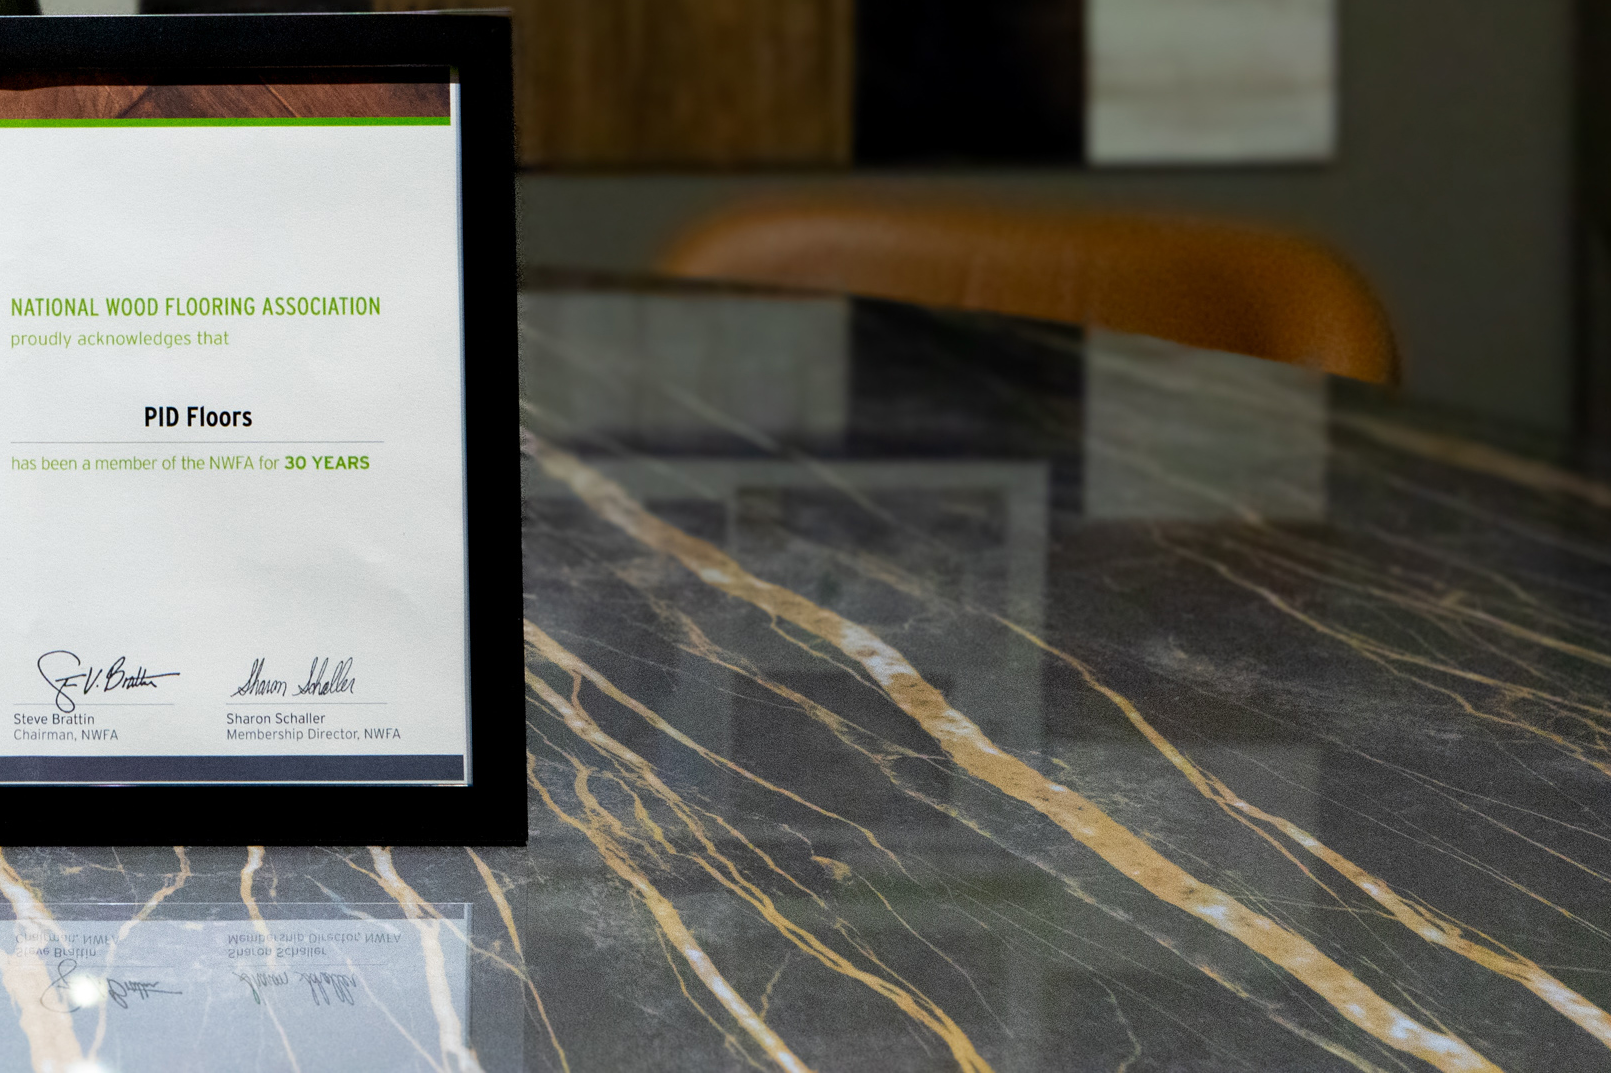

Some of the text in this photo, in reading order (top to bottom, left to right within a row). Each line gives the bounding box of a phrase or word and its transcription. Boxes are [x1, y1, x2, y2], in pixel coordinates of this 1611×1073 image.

[10, 296, 381, 317] NATIONAL WOOD FLOORING ASSOCIATION
[10, 331, 229, 348] proudly acknowledges that
[144, 405, 253, 427] PID Floors
[10, 455, 370, 471] has been a member of the NWFA for 30 YEARS
[13, 713, 95, 725] Steve Brattin
[226, 712, 326, 725] Sharon Schaller
[13, 728, 119, 742] Chairman, NWFA
[226, 727, 401, 742] Membership Director, NWFA
